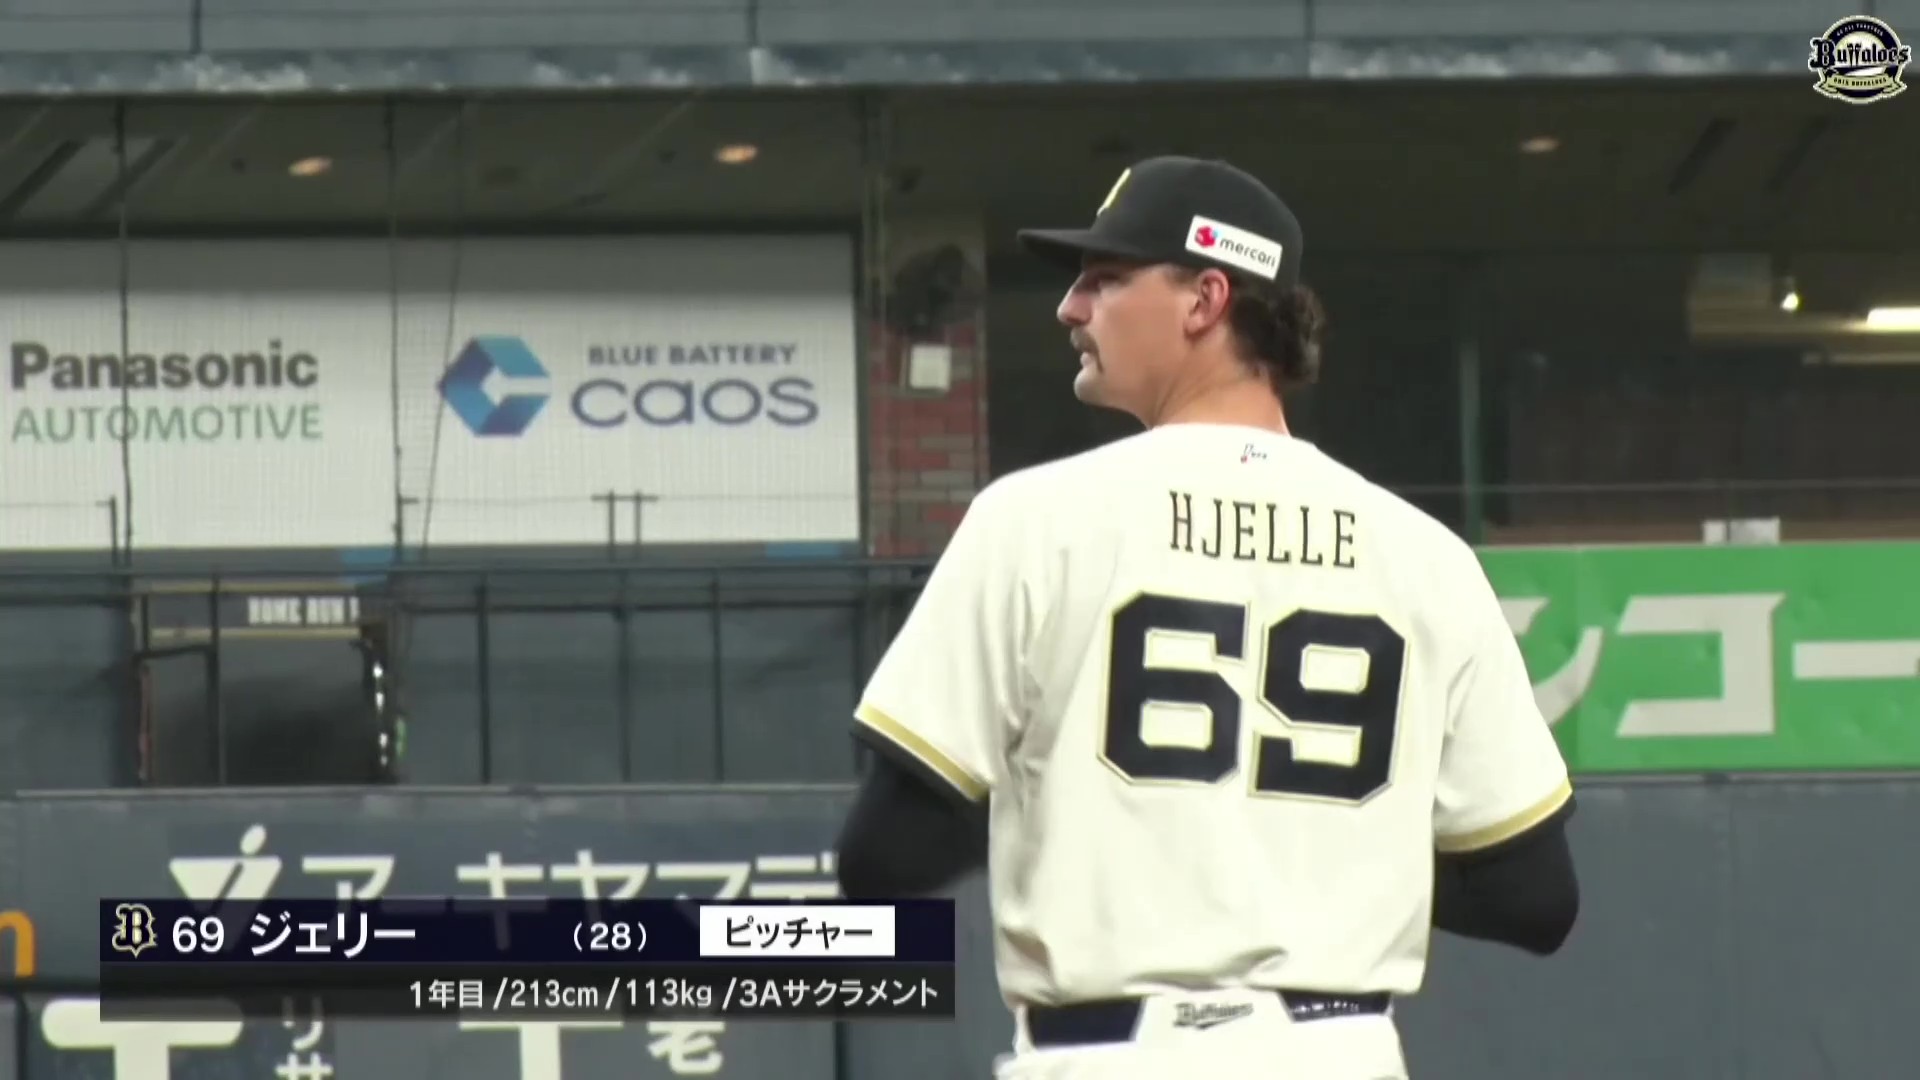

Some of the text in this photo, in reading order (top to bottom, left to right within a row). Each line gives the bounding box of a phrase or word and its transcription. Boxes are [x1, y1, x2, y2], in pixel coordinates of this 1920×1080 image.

[1219, 236, 1276, 268] mercari
[10, 338, 319, 390] Panasonic
[588, 344, 797, 366] BLUE BATTERY
[12, 404, 323, 443] AUTOMOTIVE
[571, 376, 819, 428] caos
[1168, 490, 1356, 569] HJELLE
[1097, 589, 1411, 808] 69
